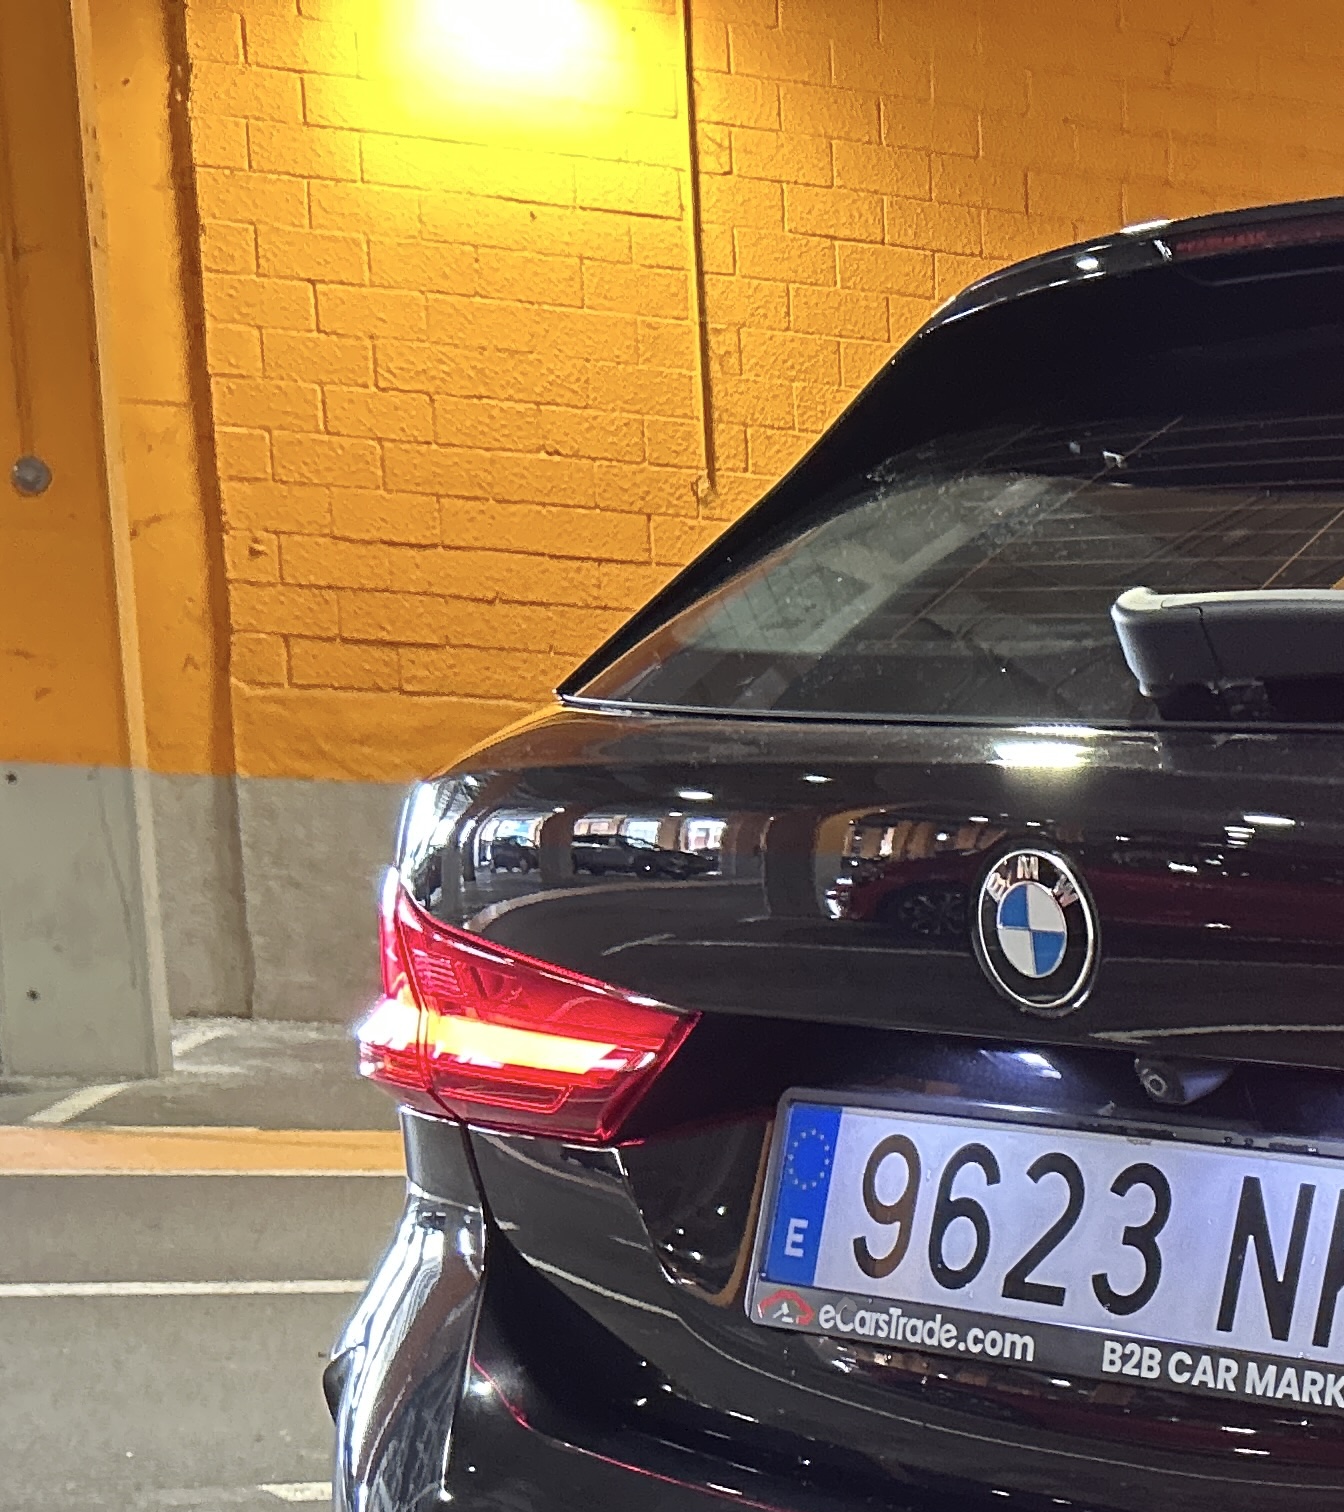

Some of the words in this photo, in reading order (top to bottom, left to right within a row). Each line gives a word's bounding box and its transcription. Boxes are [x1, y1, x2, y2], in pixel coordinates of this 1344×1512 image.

[986, 855, 1079, 907] BMW
[784, 1218, 809, 1257] E
[852, 1134, 1172, 1317] 9623
[818, 1303, 1035, 1362] eCarsTrade.com
[1102, 1340, 1163, 1379] B2B
[1167, 1351, 1236, 1392] CAR
